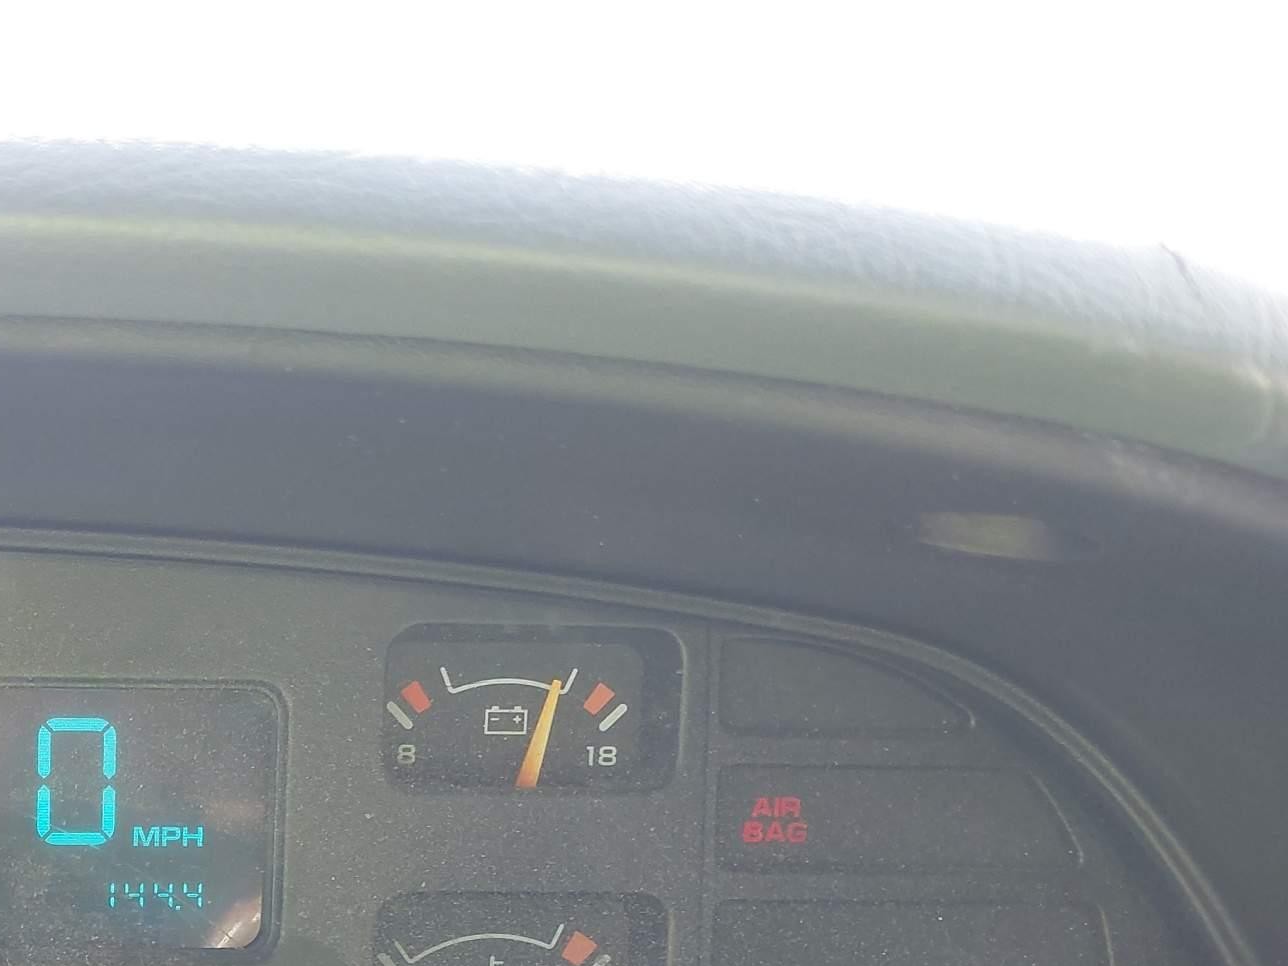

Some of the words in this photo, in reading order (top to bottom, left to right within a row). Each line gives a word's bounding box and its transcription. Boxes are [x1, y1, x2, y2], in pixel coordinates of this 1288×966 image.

[398, 744, 416, 764] 8
[586, 745, 617, 766] 18
[36, 717, 116, 846] 0
[751, 797, 802, 818] AIR
[132, 825, 205, 847] MPH
[742, 821, 808, 843] BAG
[109, 881, 203, 911] 144.4
